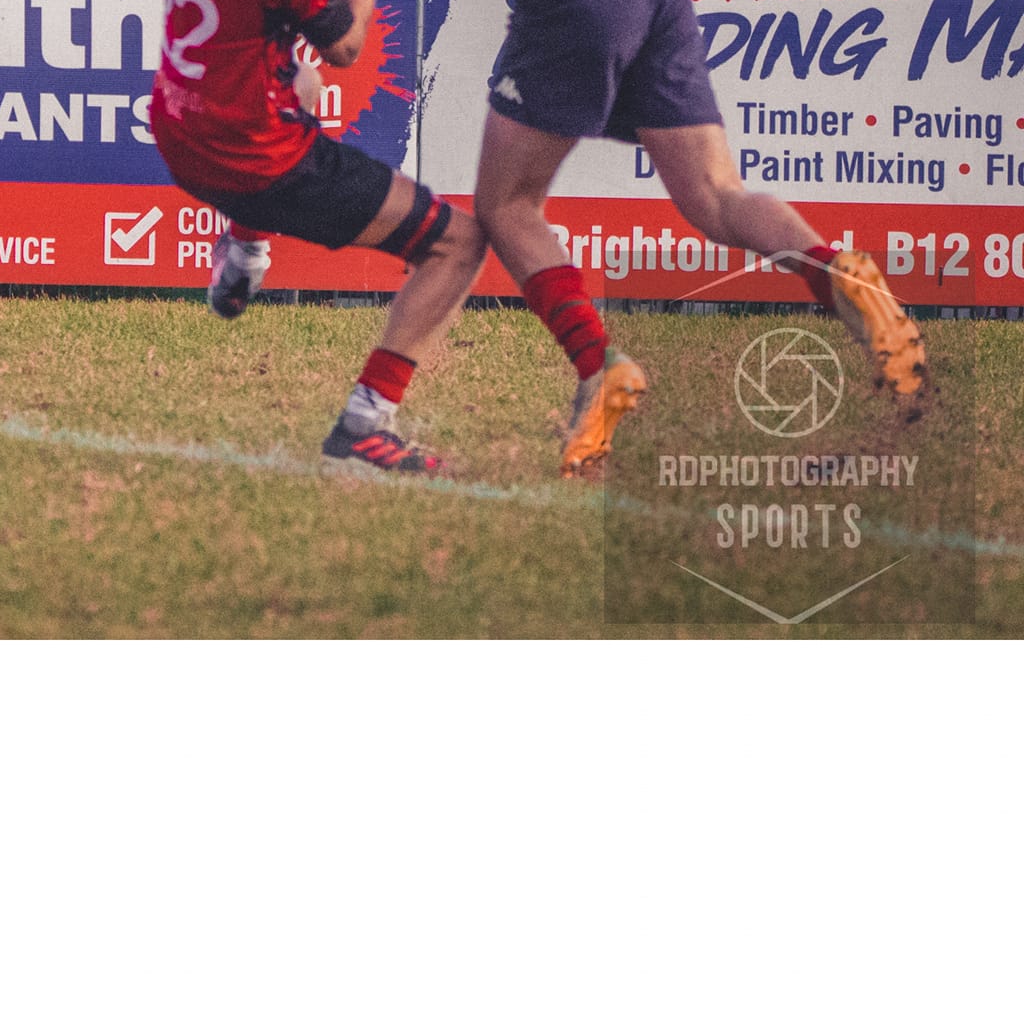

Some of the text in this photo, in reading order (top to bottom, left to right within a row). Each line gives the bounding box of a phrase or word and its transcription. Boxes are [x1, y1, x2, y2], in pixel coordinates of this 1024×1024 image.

[737, 102, 1002, 147] Timber Paving
[740, 149, 823, 182] Paint
[836, 151, 945, 192] Mixing
[888, 231, 969, 276] B12
